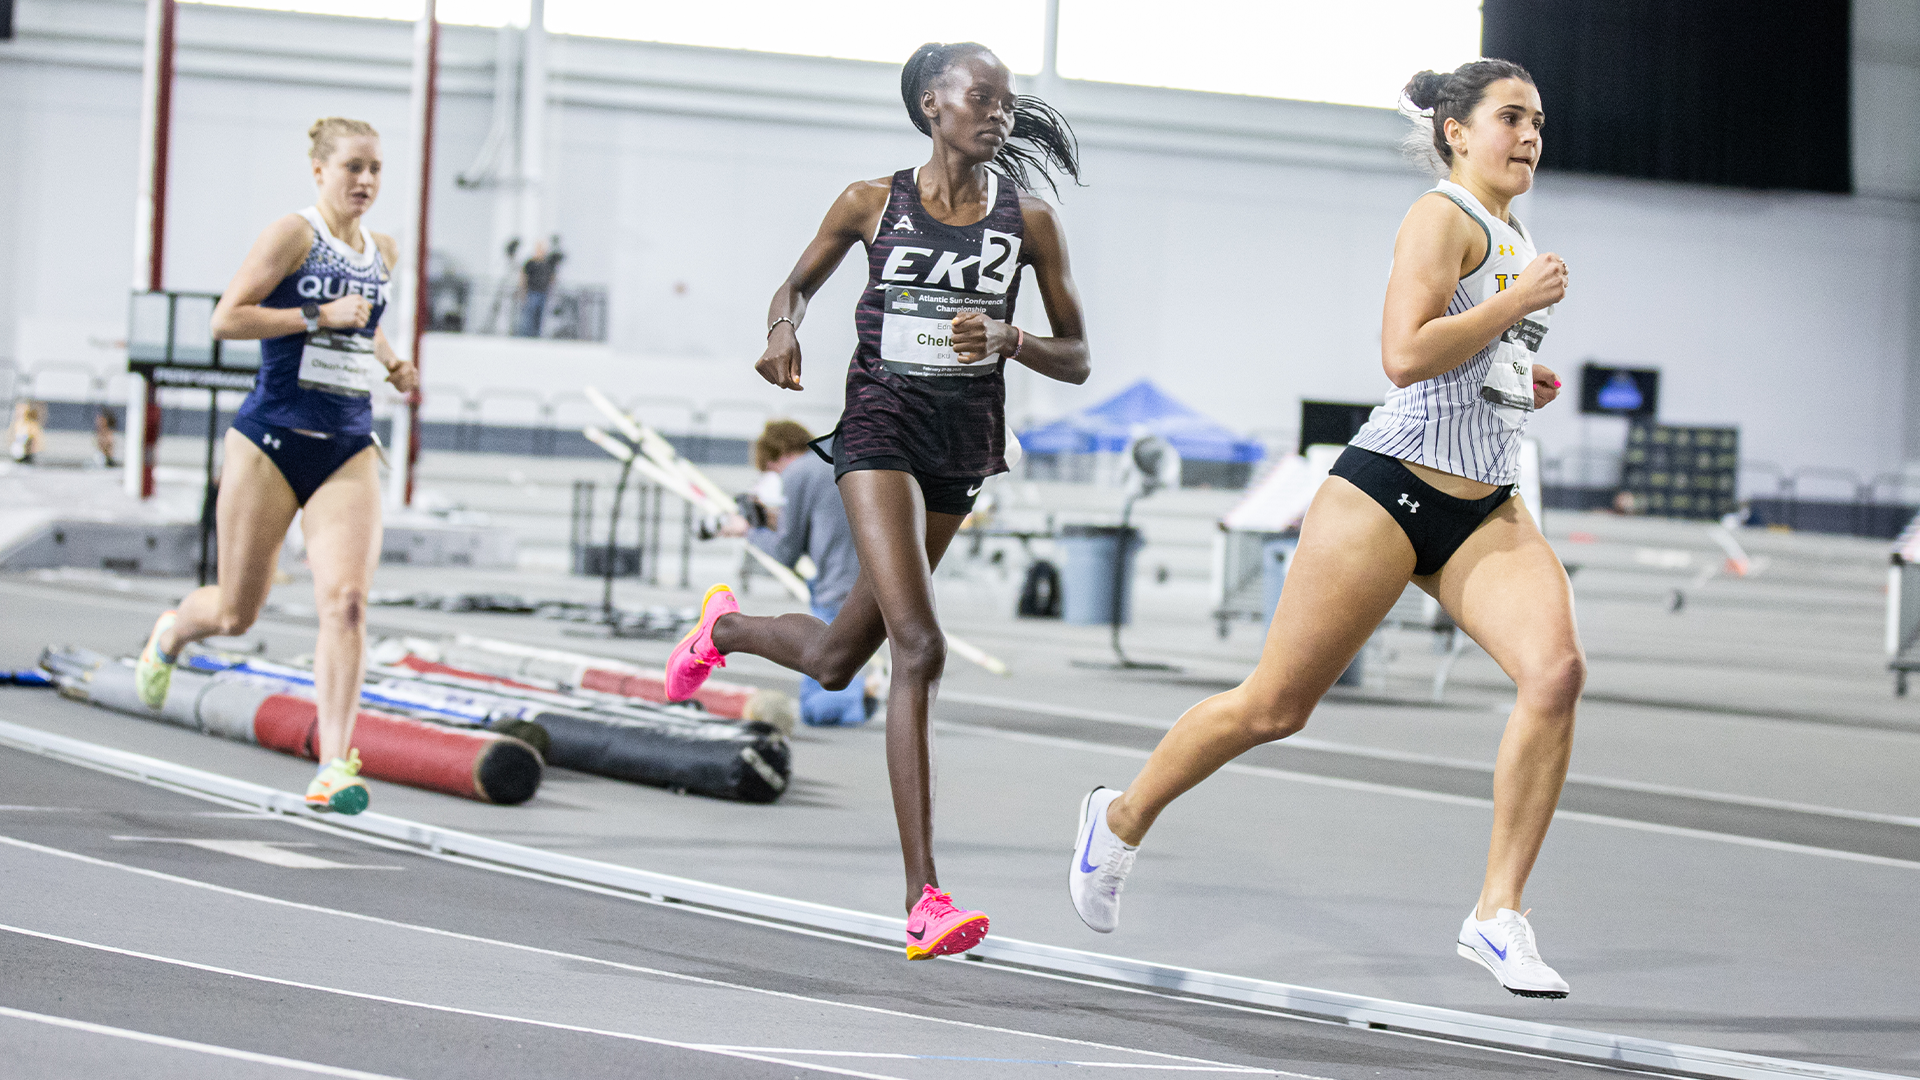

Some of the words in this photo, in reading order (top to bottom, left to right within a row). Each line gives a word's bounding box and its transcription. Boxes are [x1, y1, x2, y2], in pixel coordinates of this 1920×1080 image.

[981, 236, 1012, 283] 2
[881, 245, 1000, 290] EK
[918, 294, 949, 304] Atlantic
[949, 296, 963, 304] Sun
[964, 297, 1004, 306] Conference
[935, 304, 987, 313] Championship
[937, 352, 951, 360] EKU
